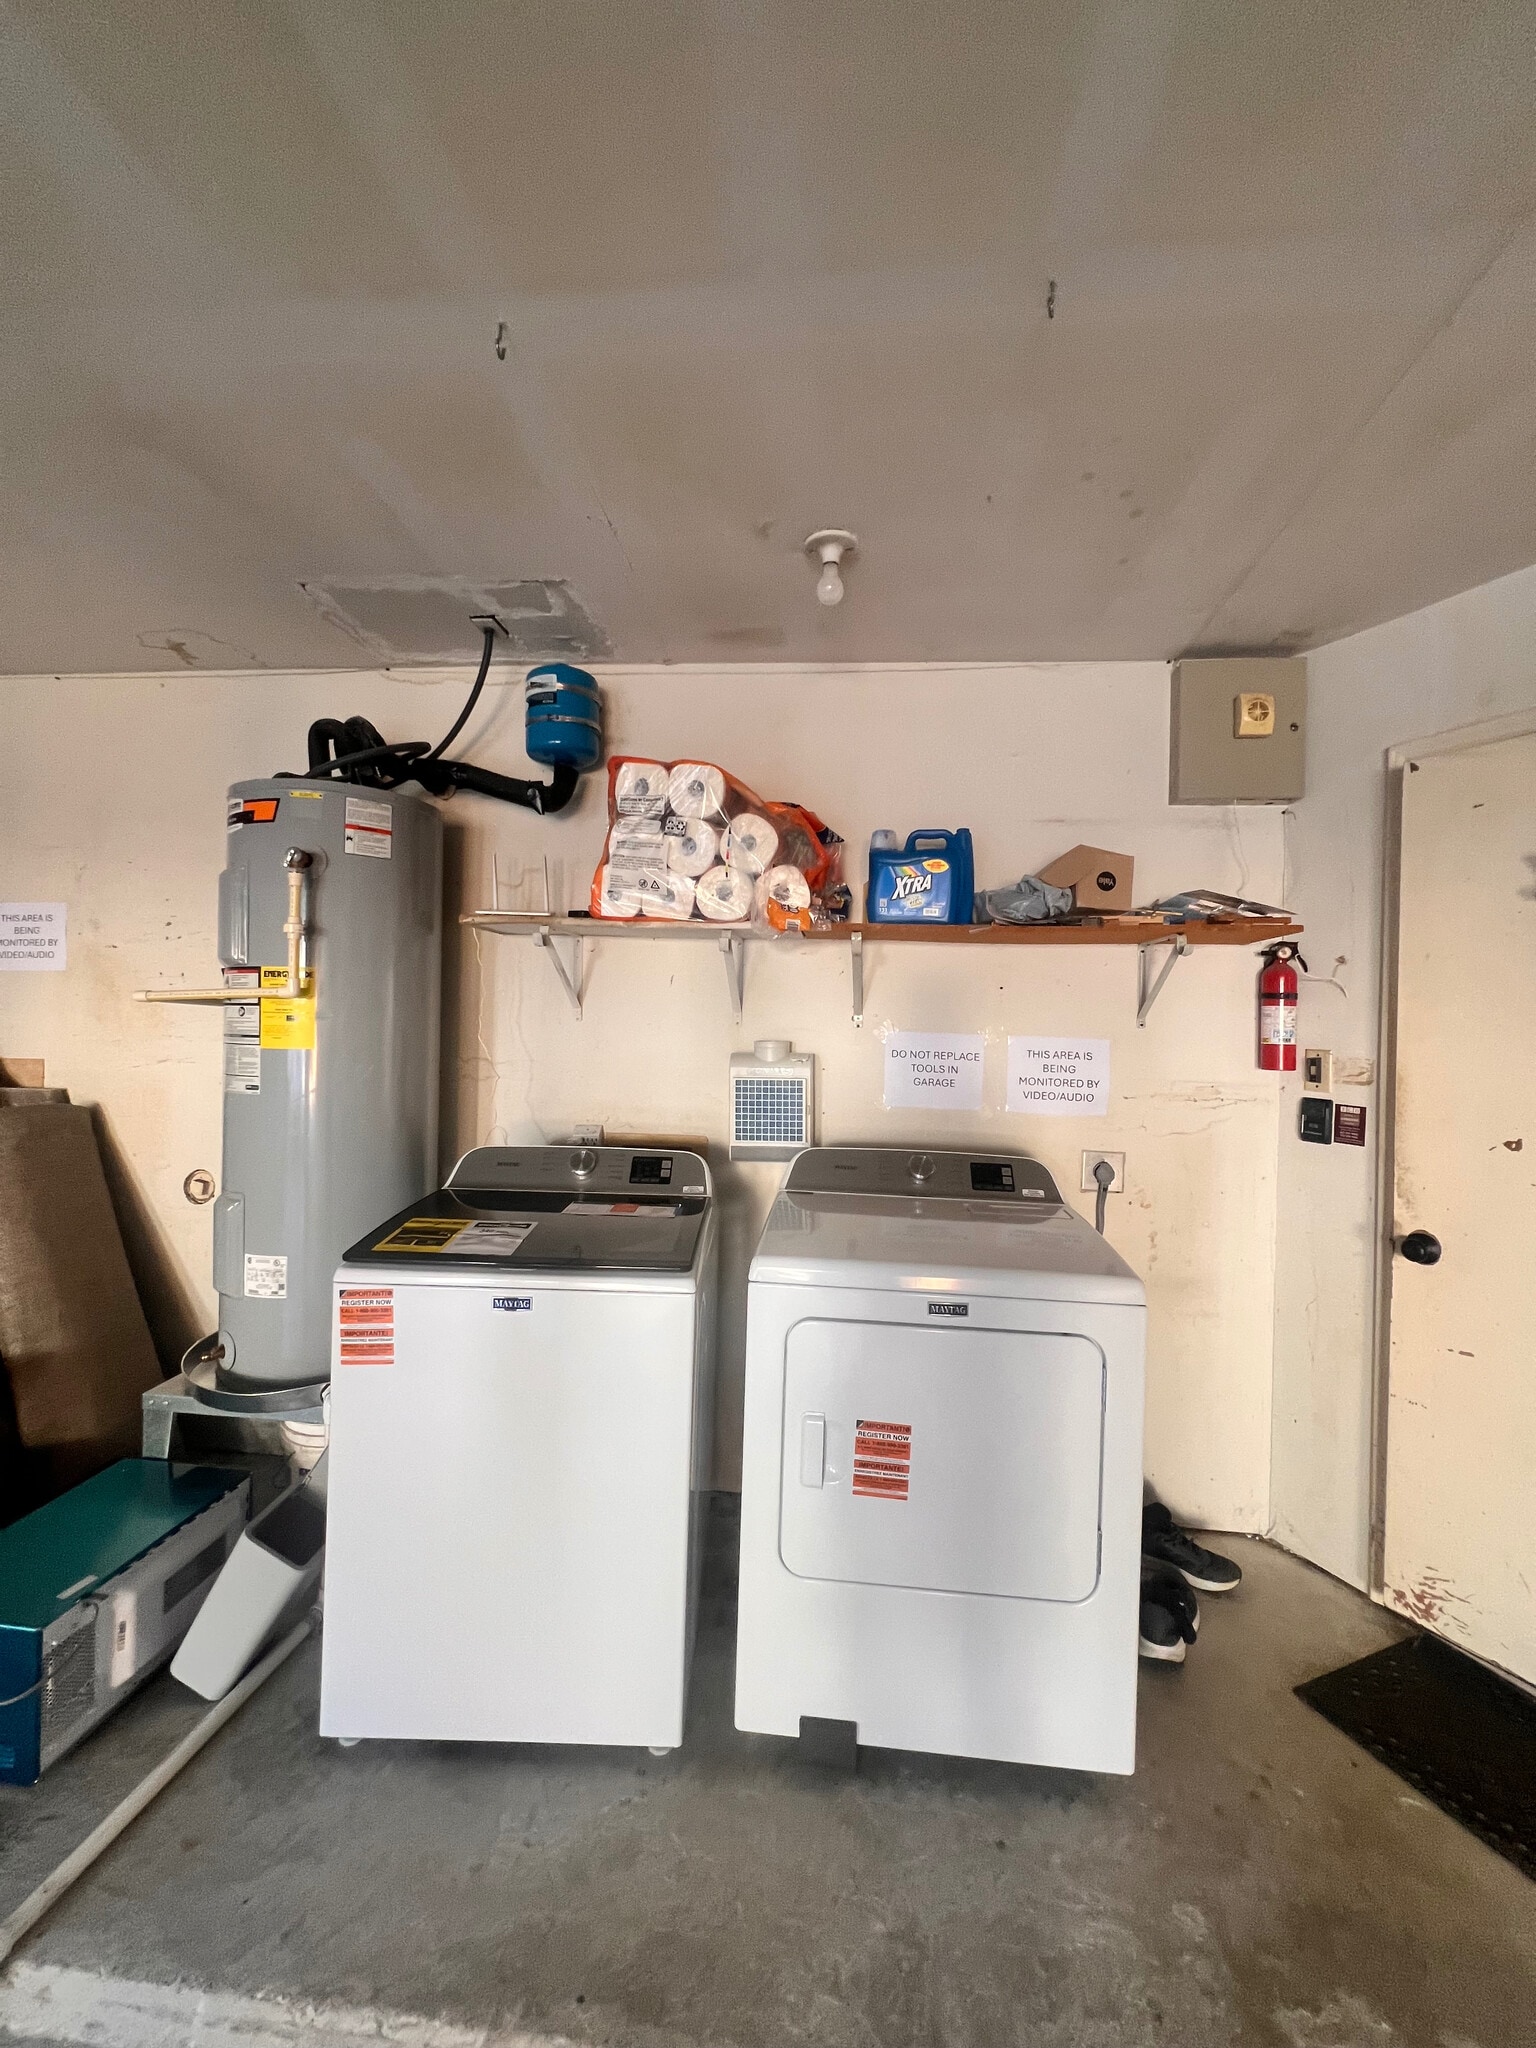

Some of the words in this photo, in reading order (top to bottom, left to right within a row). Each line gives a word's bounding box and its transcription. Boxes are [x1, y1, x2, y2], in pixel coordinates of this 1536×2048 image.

[1098, 877, 1115, 886] Yale
[891, 874, 932, 900] XTRA
[1, 914, 20, 922] THIS
[21, 914, 43, 922] AREA
[45, 914, 53, 922] IS
[14, 926, 40, 935] BEING
[47, 938, 58, 947] BY
[0, 950, 55, 959] VIDEO/AUDIO
[891, 1049, 907, 1059] DO
[909, 1050, 931, 1060] NOT
[933, 1051, 980, 1062] REPLACE
[1027, 1049, 1051, 1060] THIS
[1052, 1050, 1081, 1061] AREA
[1083, 1051, 1093, 1061] IS
[911, 1063, 946, 1074] TOOLS
[947, 1065, 959, 1075] IN
[1042, 1063, 1077, 1075] BEING
[913, 1077, 956, 1088] GARAGE
[1018, 1076, 1085, 1089] MONITORED
[1086, 1079, 1100, 1089] BY
[1022, 1090, 1095, 1103] VIDEO/AUDIO
[494, 1299, 530, 1309] MAYTAG
[931, 1305, 966, 1314] MAYTAG
[857, 1431, 892, 1440] REGISTER
